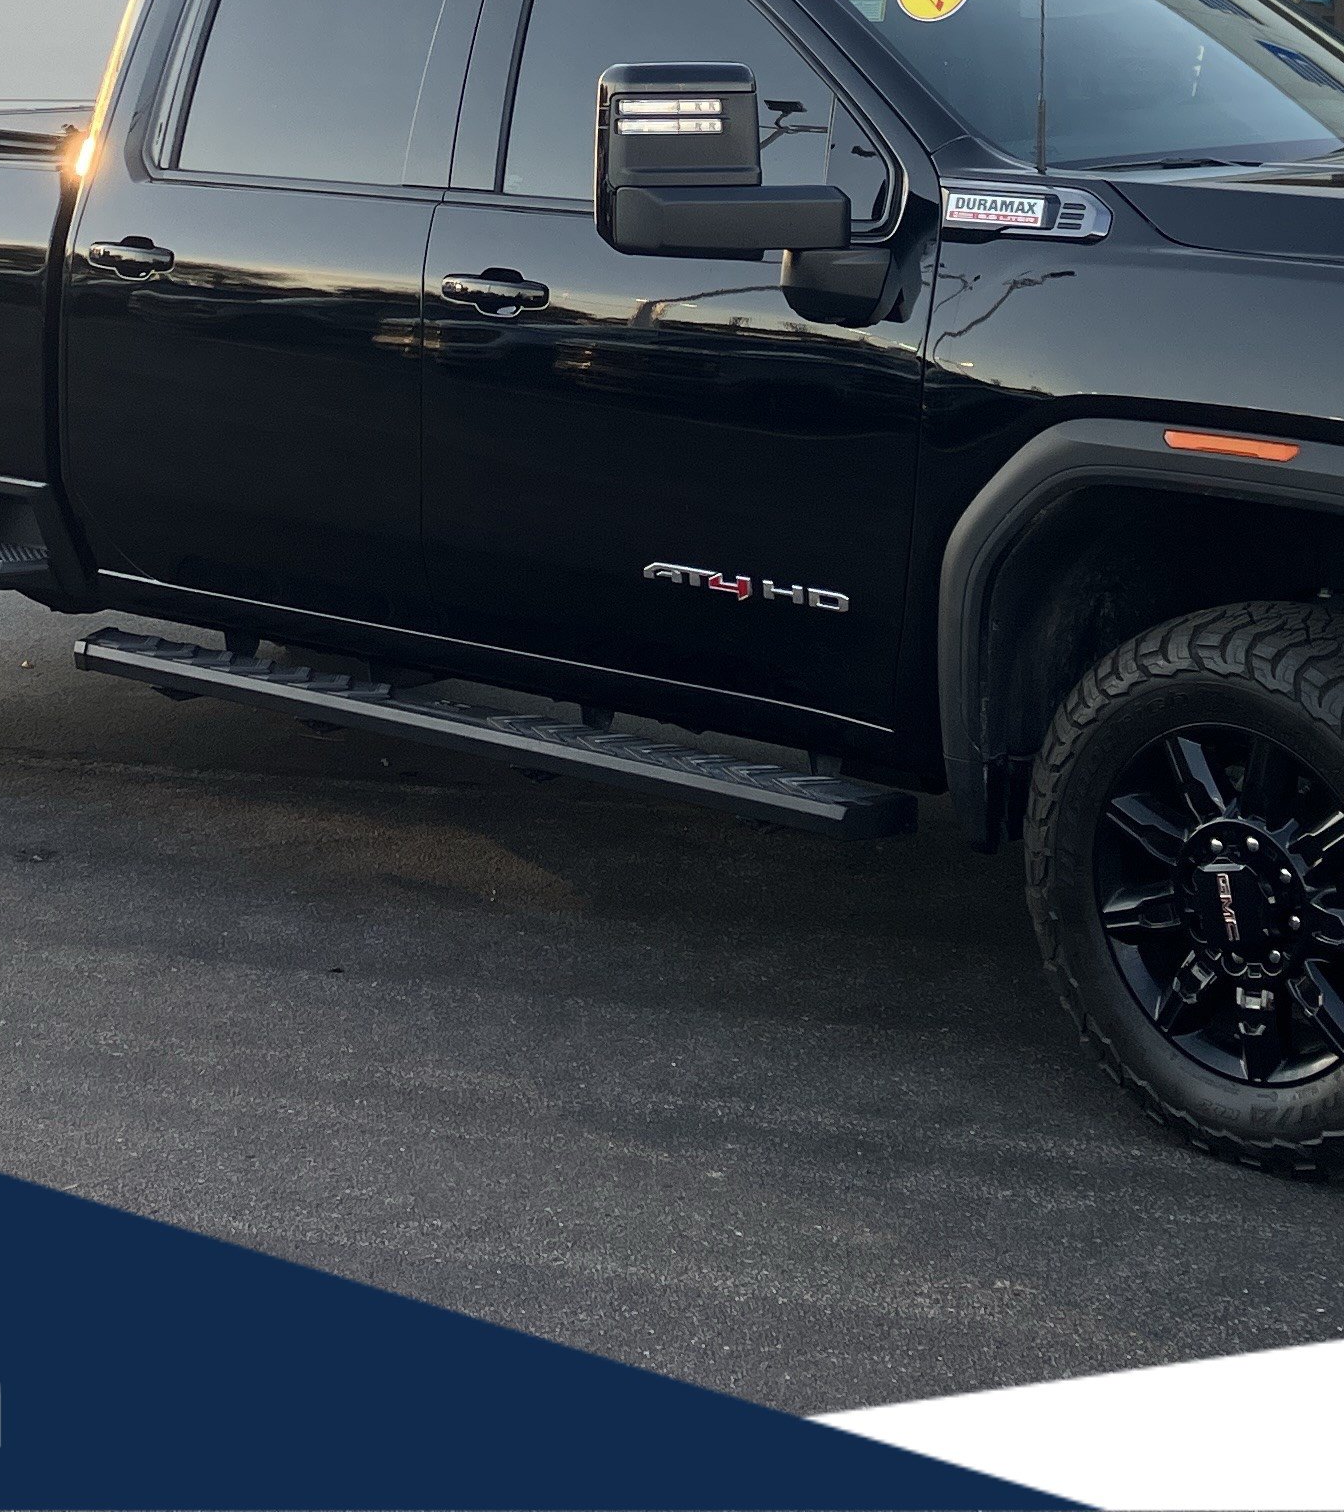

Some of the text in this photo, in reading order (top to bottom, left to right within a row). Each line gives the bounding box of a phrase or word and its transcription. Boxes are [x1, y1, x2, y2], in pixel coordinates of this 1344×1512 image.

[956, 197, 1038, 214] DURAMAX
[643, 561, 850, 613] AT4 HD
[1216, 872, 1240, 941] GMC
